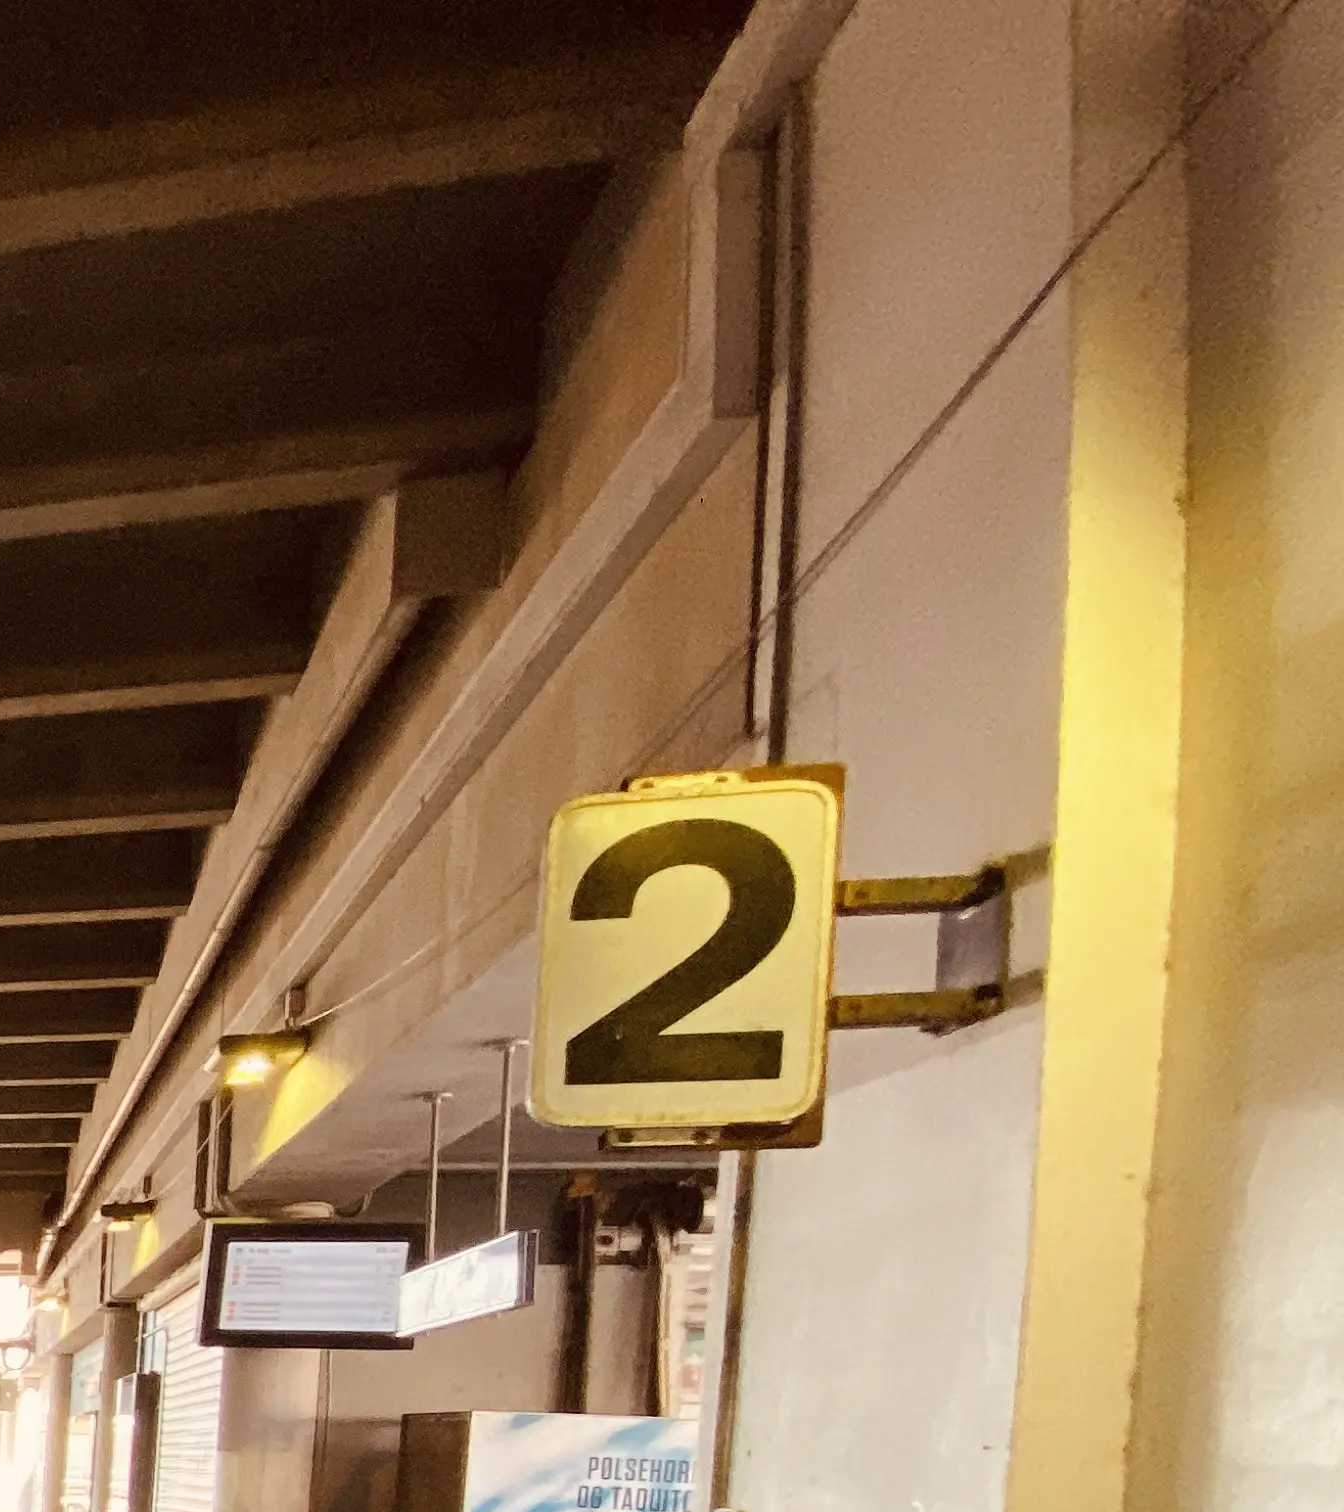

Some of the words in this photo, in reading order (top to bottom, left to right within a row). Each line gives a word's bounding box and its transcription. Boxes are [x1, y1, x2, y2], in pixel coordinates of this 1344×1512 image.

[564, 818, 796, 1086] 2
[588, 1456, 696, 1484] PØLSEHOR
[577, 1485, 603, 1509] OG
